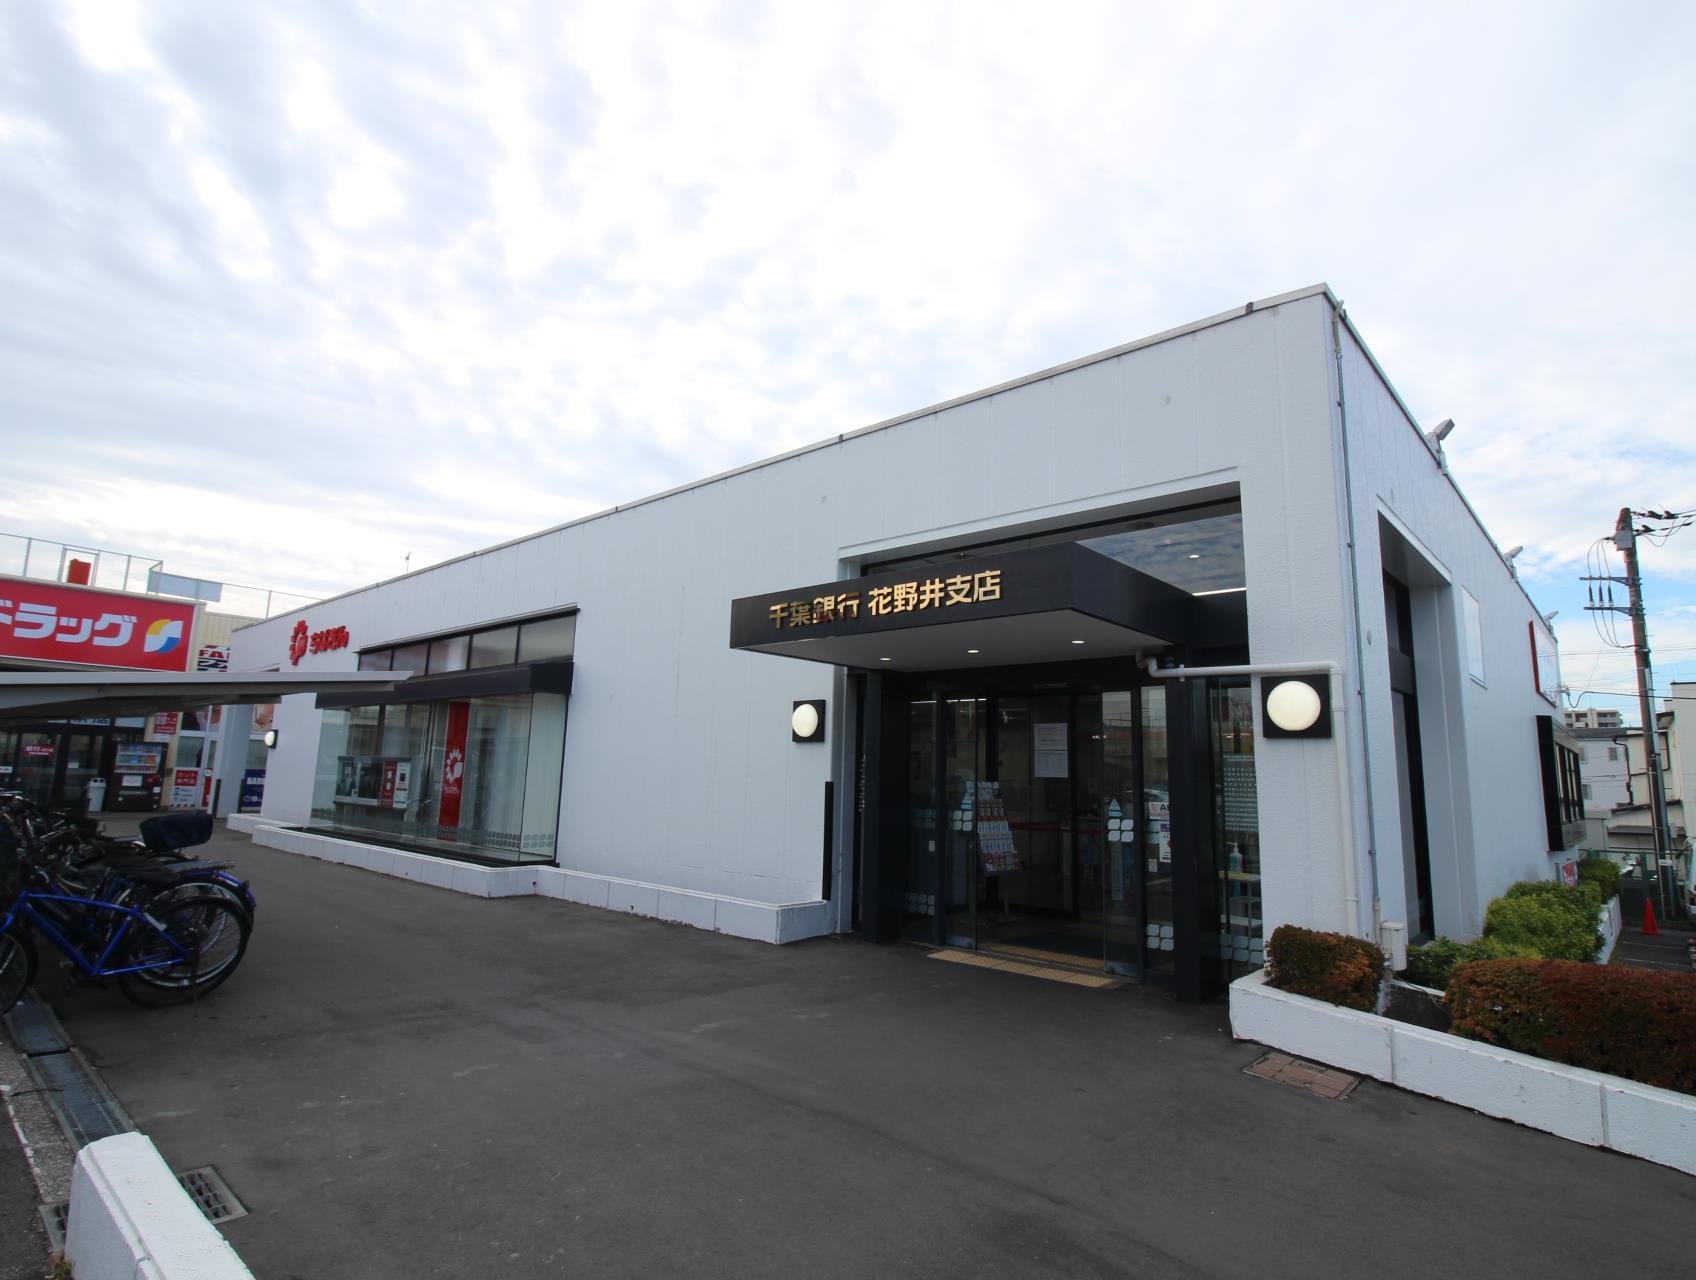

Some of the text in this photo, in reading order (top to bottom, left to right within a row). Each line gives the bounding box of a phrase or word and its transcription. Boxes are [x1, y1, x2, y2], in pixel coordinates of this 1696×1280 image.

[768, 569, 1001, 629] 千葉銀行 花野井支店
